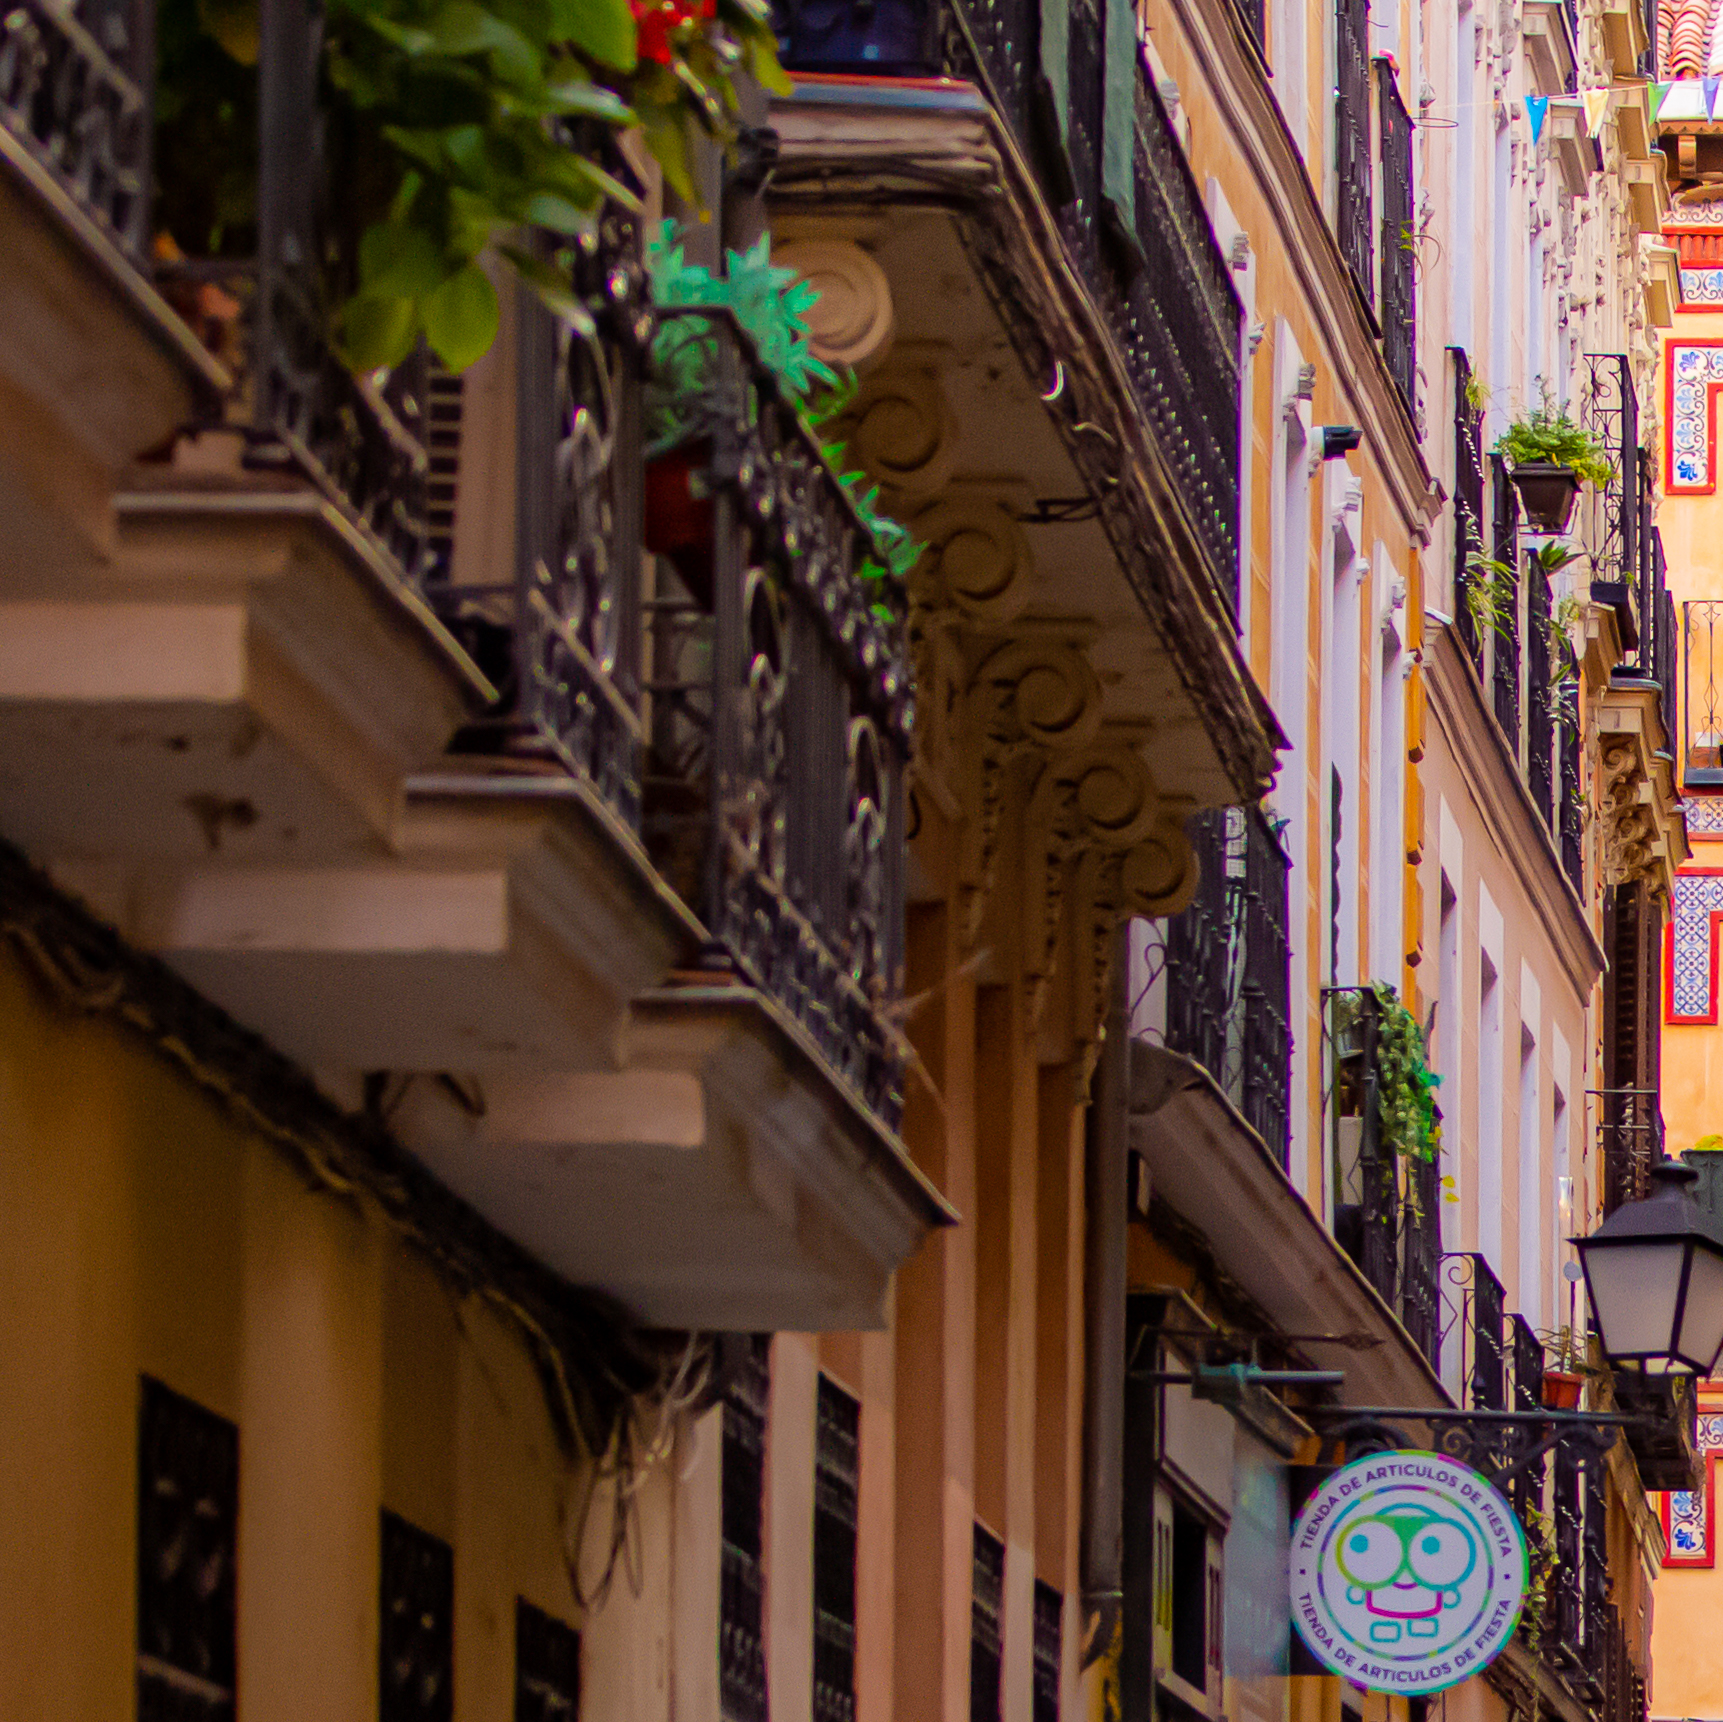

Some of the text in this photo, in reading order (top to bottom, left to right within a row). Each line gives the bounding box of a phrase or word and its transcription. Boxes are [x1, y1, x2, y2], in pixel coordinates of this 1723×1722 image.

[1300, 1464, 1513, 1558] TIENDA DE ARTICULOS DE FIESTA
[1298, 1592, 1512, 1683] TIENDA DE ARTICULOS DE FIESTA
